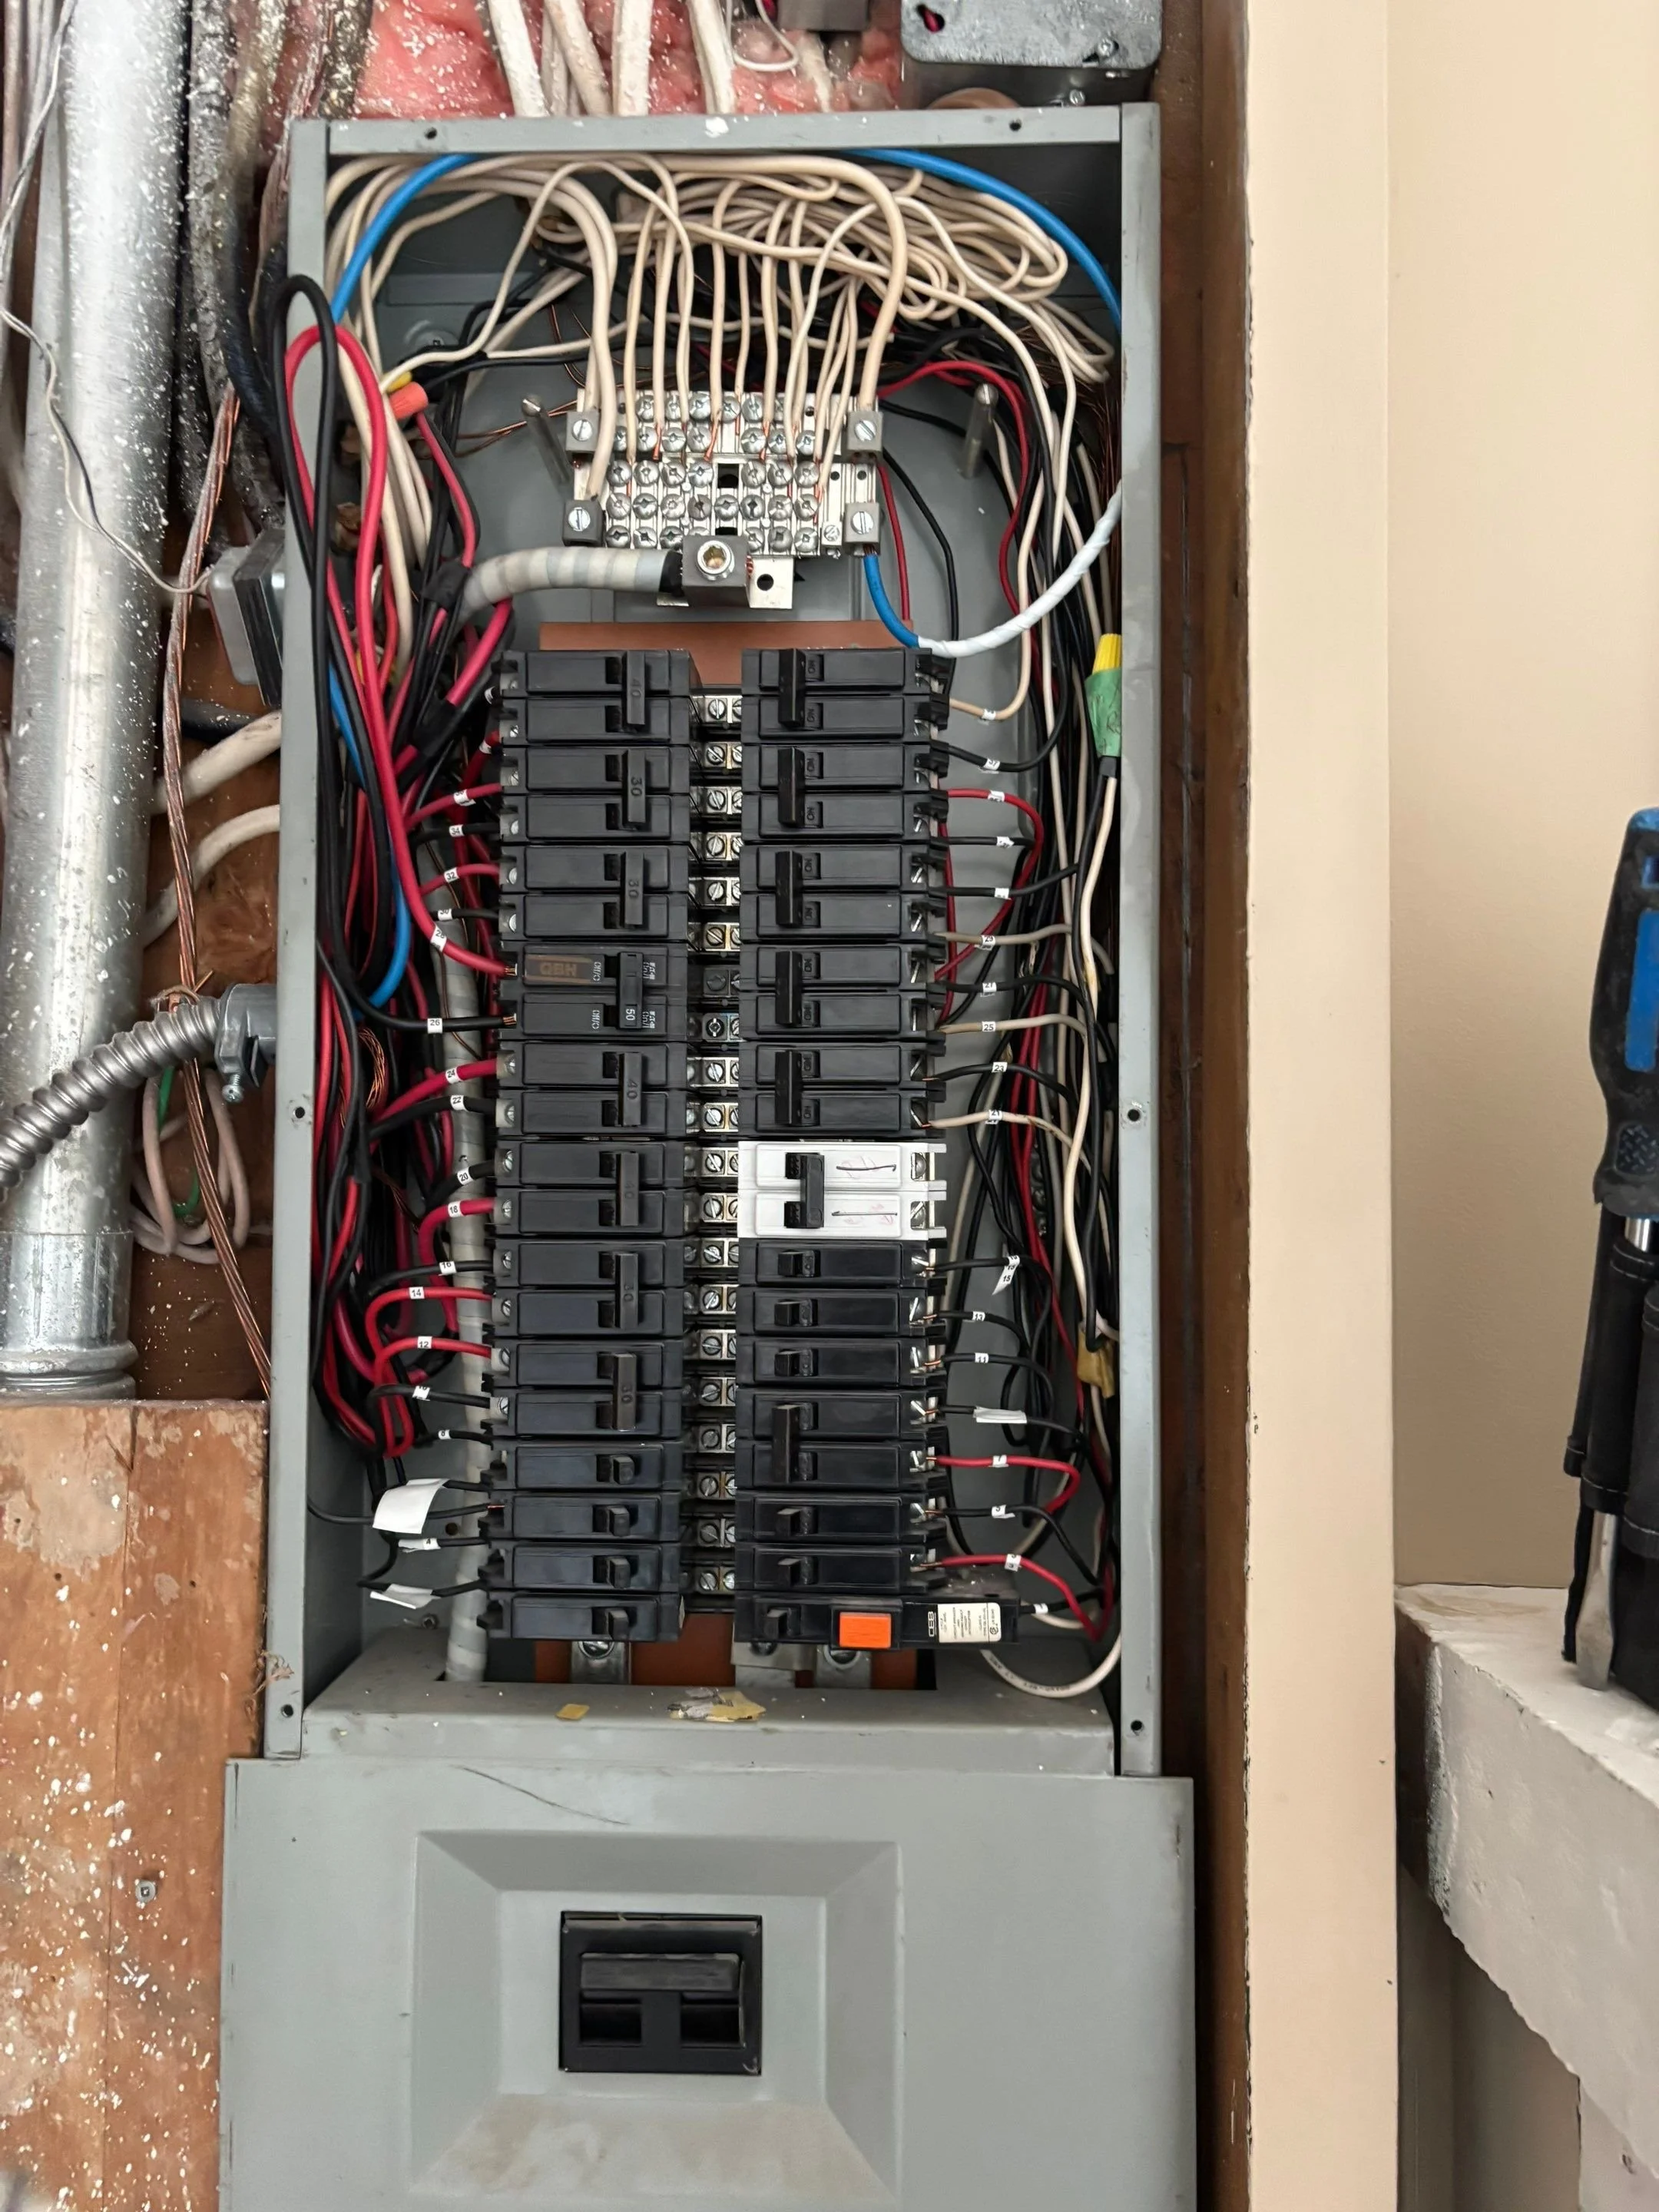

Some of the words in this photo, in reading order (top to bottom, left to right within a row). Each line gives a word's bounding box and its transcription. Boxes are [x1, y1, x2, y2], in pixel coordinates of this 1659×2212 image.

[630, 678, 642, 698] 40
[630, 777, 643, 797] 30
[450, 826, 461, 835] 34
[445, 870, 457, 880] 32
[628, 879, 640, 899] 30
[625, 1008, 636, 1022] 50
[984, 1023, 995, 1031] 25
[446, 1069, 456, 1079] 24
[626, 1079, 638, 1100] 40
[452, 1096, 462, 1104] 22
[459, 1172, 469, 1181] 20
[449, 1205, 459, 1214] 18
[412, 1289, 422, 1297] 14
[419, 1340, 429, 1349] 12
[621, 1385, 634, 1405] 30
